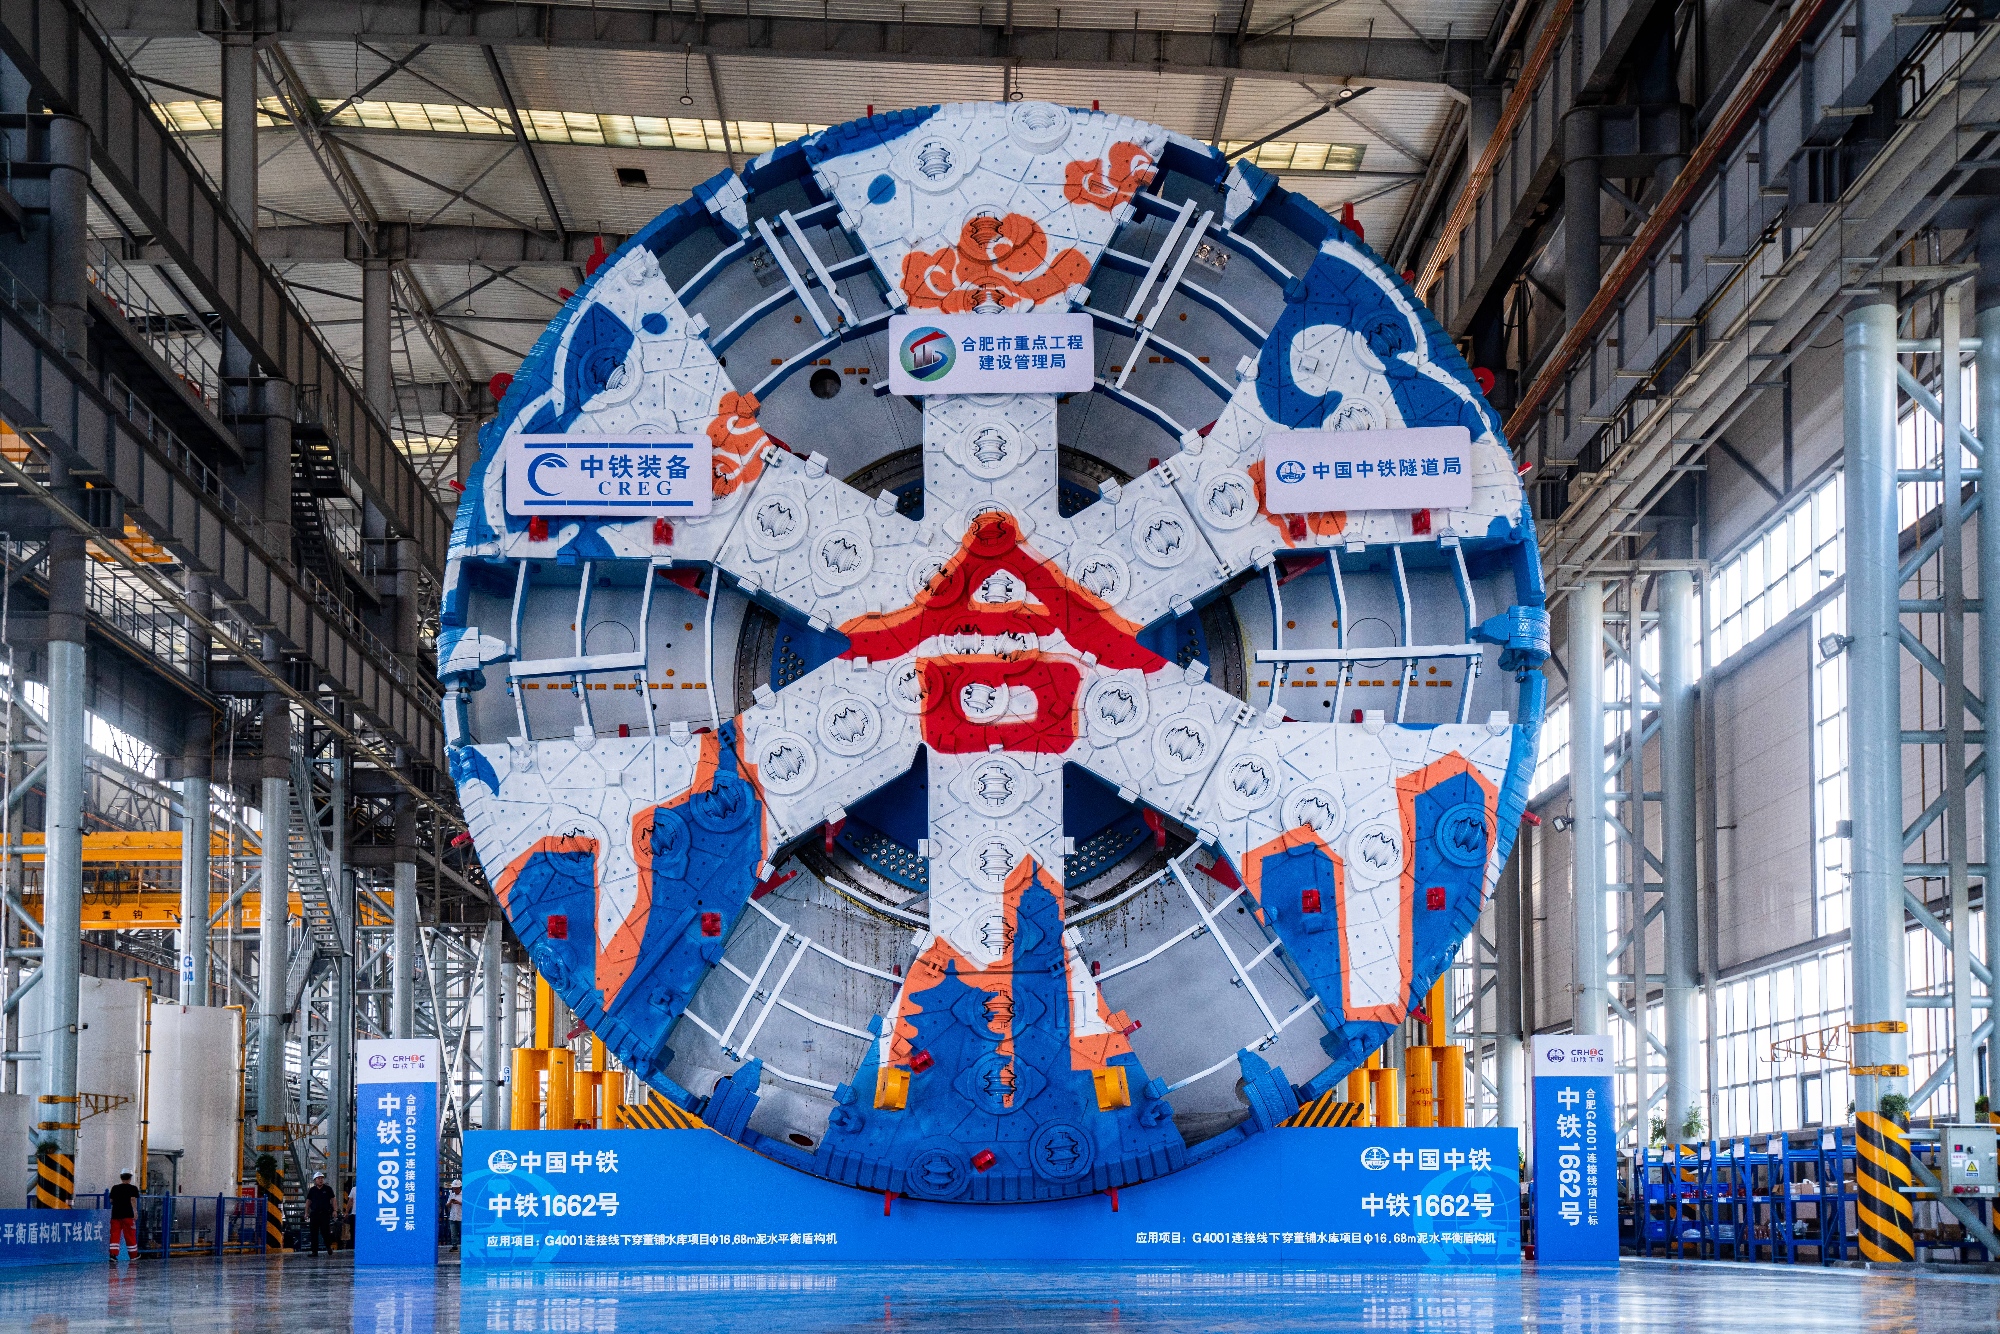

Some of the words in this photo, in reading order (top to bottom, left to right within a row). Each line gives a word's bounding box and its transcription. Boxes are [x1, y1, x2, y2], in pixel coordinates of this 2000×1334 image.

[961, 334, 1084, 352] 合肥市重点工程
[978, 353, 1066, 371] 建设管理局
[580, 454, 691, 480] 中铁装备
[1312, 456, 1462, 480] 中国中铁隧道局
[598, 480, 672, 496] CREG
[375, 1092, 402, 1232] 中铁1662号
[404, 1093, 417, 1231] 合肥G4001连接线项目1标
[520, 1149, 619, 1174] 中国中铁
[1393, 1147, 1492, 1172] 中国中铁
[1556, 1086, 1583, 1226] 中铁1662号
[1585, 1088, 1599, 1226] 合肥G4001连接线项目1标
[488, 1192, 620, 1218] 中铁1662号
[1361, 1192, 1495, 1218] 中铁1662号
[0, 1221, 104, 1245] 平衡盾构机下线仪式
